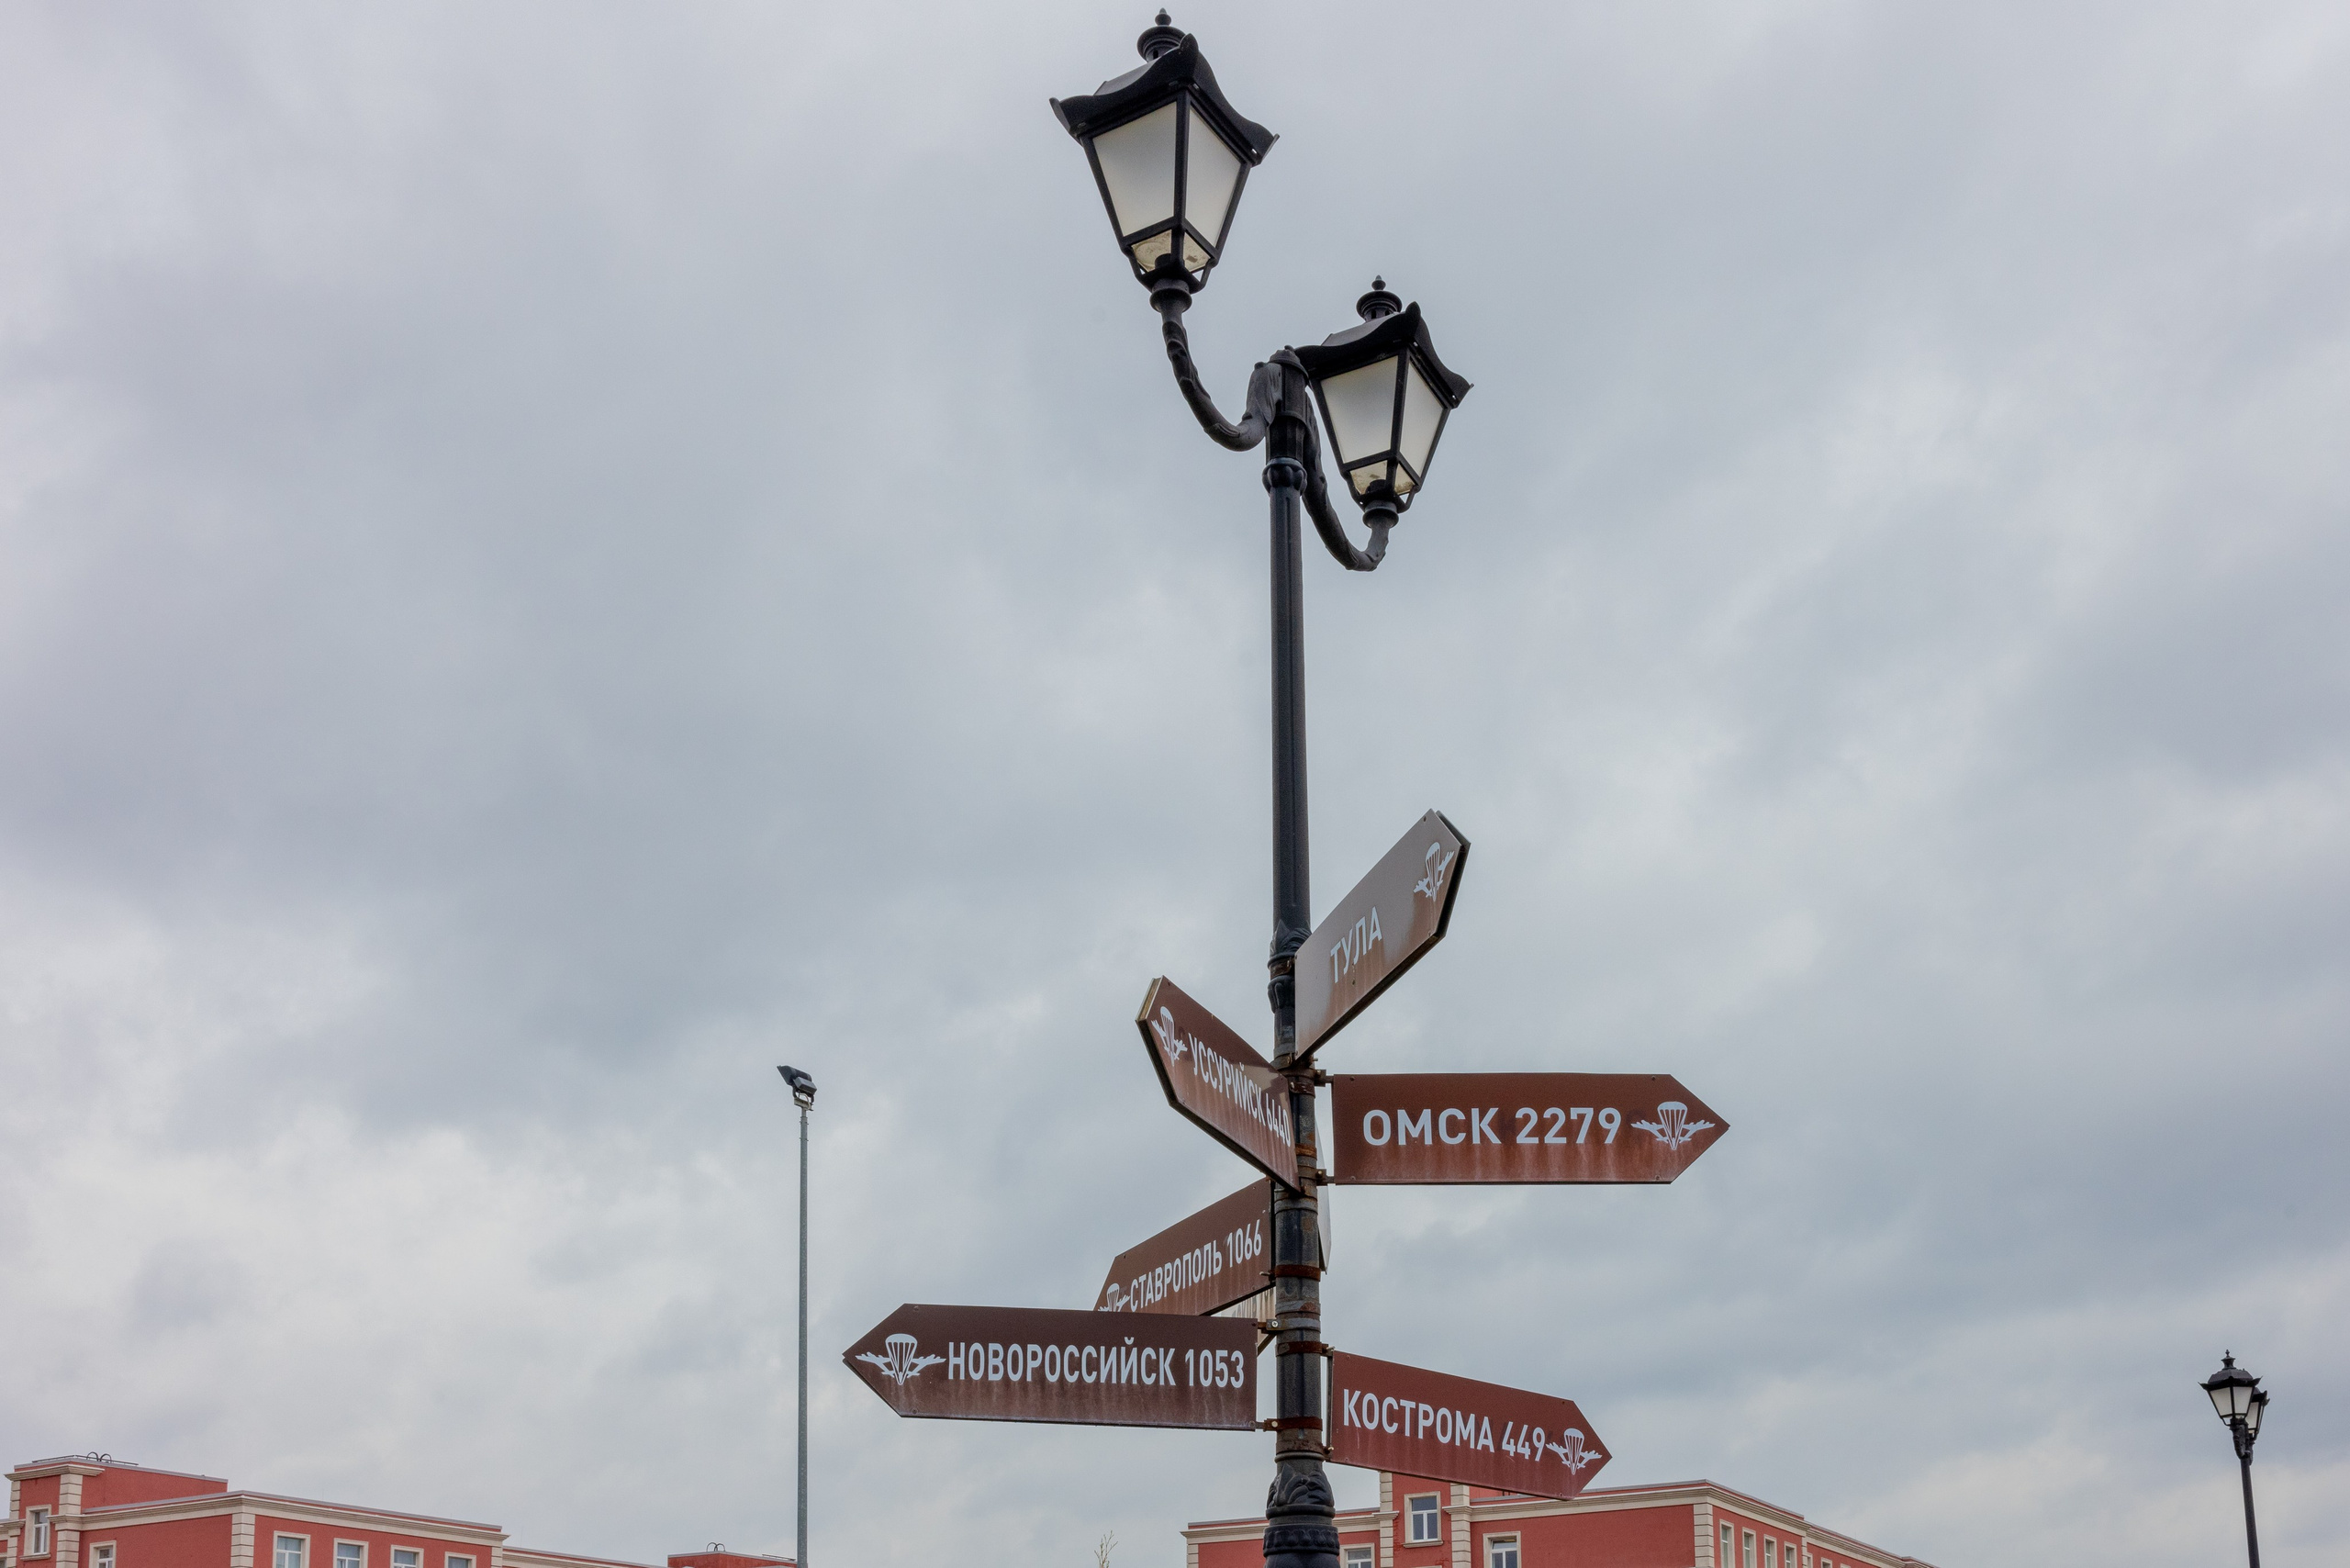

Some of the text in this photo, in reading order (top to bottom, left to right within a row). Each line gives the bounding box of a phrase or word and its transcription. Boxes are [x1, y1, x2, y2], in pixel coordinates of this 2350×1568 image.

[1330, 906, 1382, 984] ТУЛА
[1188, 1032, 1291, 1148] УССУРИЙСК 6440
[1362, 1107, 1622, 1146] ОМСК 2279
[1130, 1239, 1223, 1313] СТАВРОПОЛЬ
[1227, 1219, 1262, 1268] 1066
[947, 1337, 1245, 1388] НОВОРОССИЙСК 1053
[1343, 1389, 1545, 1462] КОСТРОМА 449
